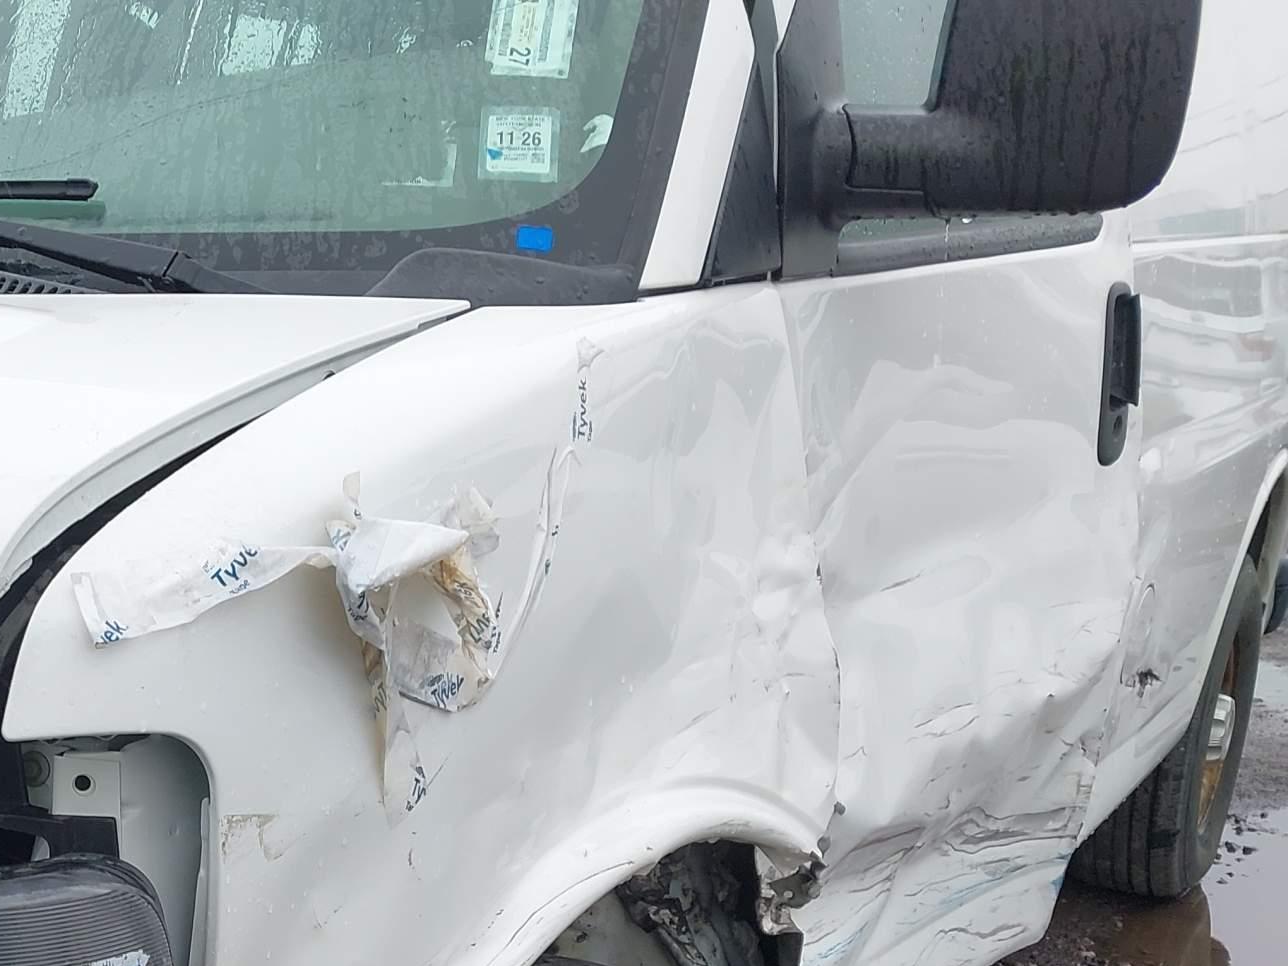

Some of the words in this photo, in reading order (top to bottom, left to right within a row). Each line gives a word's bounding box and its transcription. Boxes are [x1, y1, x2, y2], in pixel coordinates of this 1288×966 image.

[509, 47, 531, 66] 27
[497, 131, 514, 145] 11
[521, 131, 542, 146] 26
[577, 375, 588, 440] Tyvek
